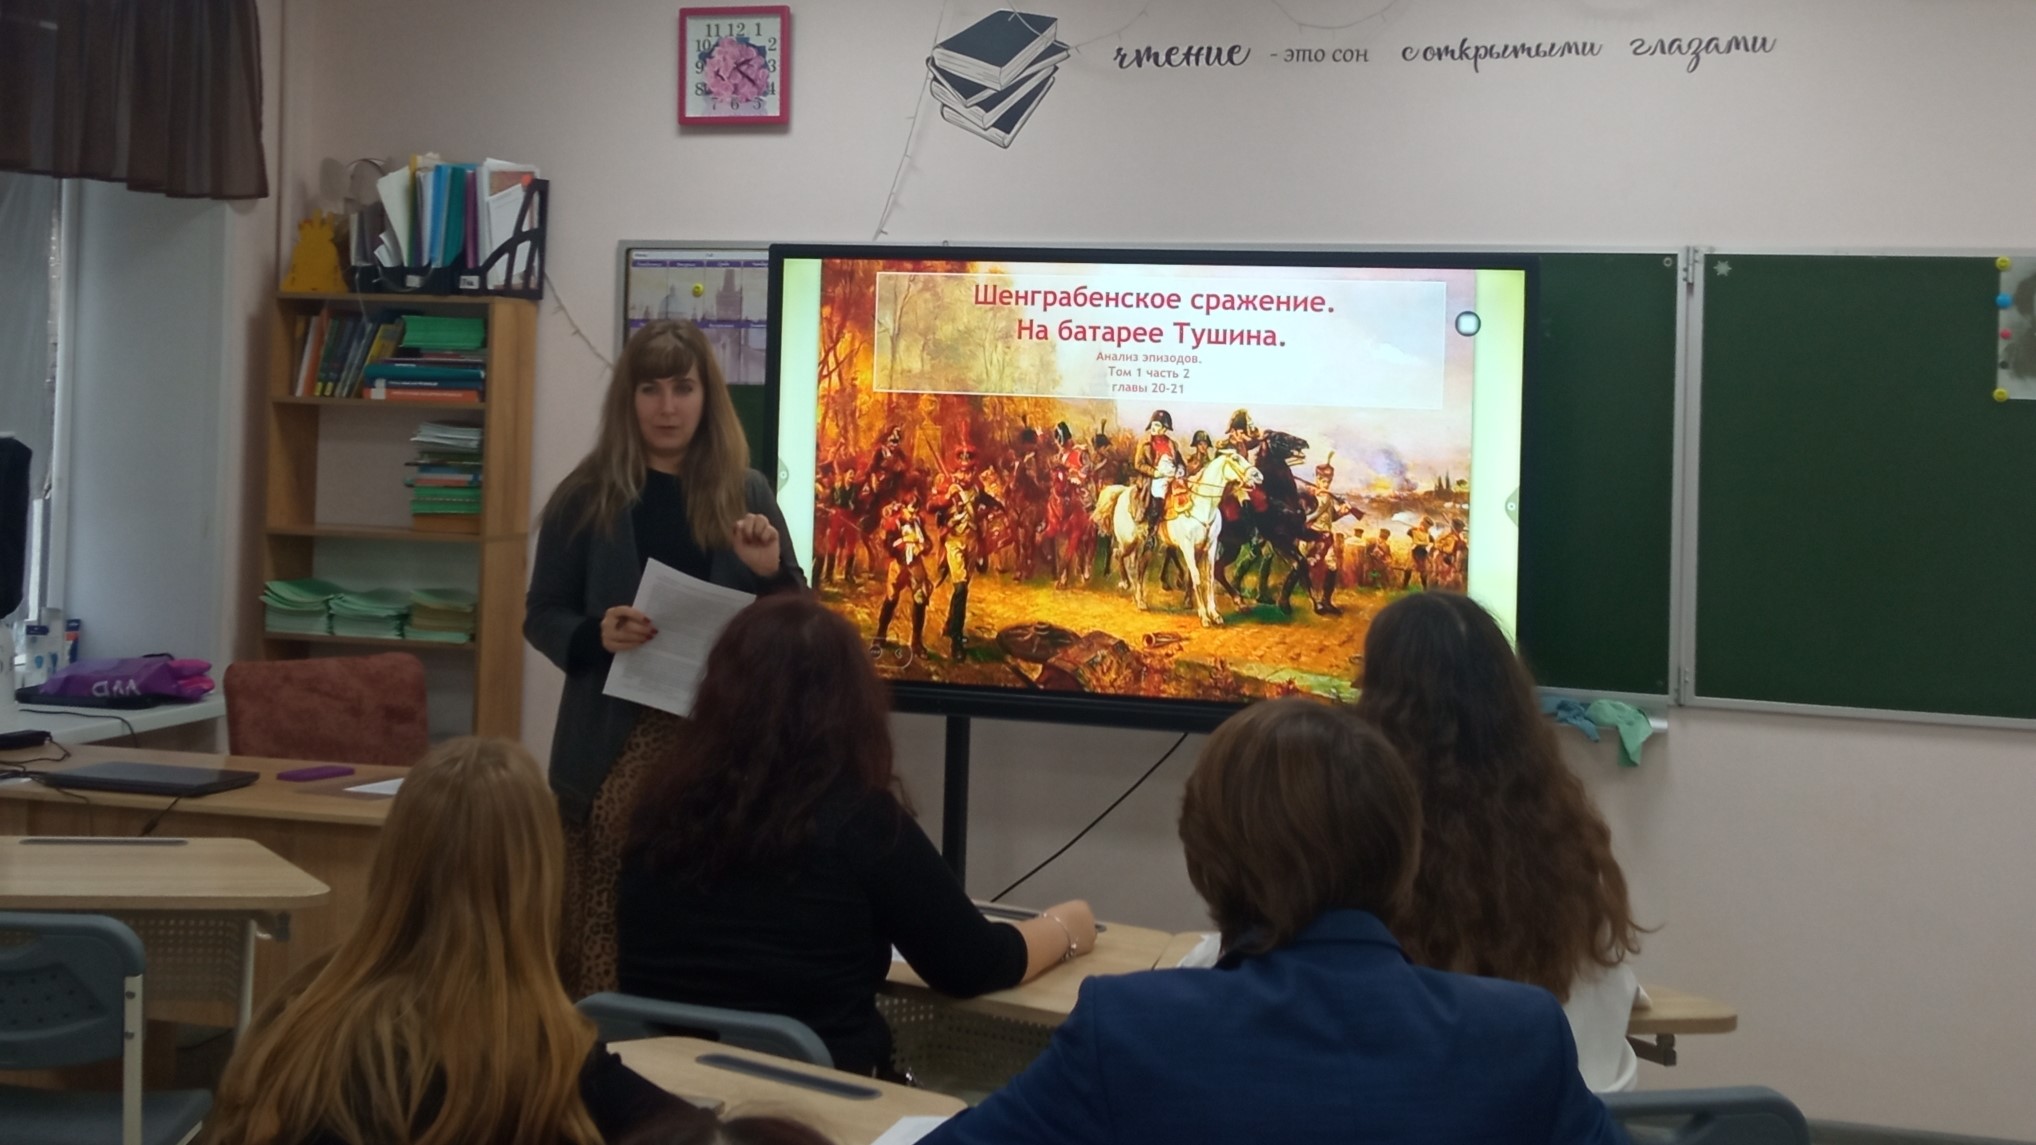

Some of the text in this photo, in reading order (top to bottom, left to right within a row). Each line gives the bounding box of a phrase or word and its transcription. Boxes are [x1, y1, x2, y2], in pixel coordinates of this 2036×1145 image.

[705, 22, 762, 38] 11 12 1
[696, 38, 711, 52] 10
[768, 37, 777, 51] 2
[1113, 44, 1252, 69] чтение
[1283, 48, 1326, 63] это
[1331, 48, 1369, 63] сон
[1629, 34, 1779, 74] глазами
[695, 61, 704, 74] 9
[768, 59, 777, 73] 3
[694, 82, 704, 97] 8
[730, 97, 740, 110] 6
[974, 284, 1335, 316] Шенграбенское сражение.
[1016, 318, 1287, 350] На батарее Тушина.
[1096, 352, 1203, 365] Анализ эпизодов.
[1109, 366, 1190, 379] Том 1 часть 2
[1112, 383, 1184, 394] главы 20-21
